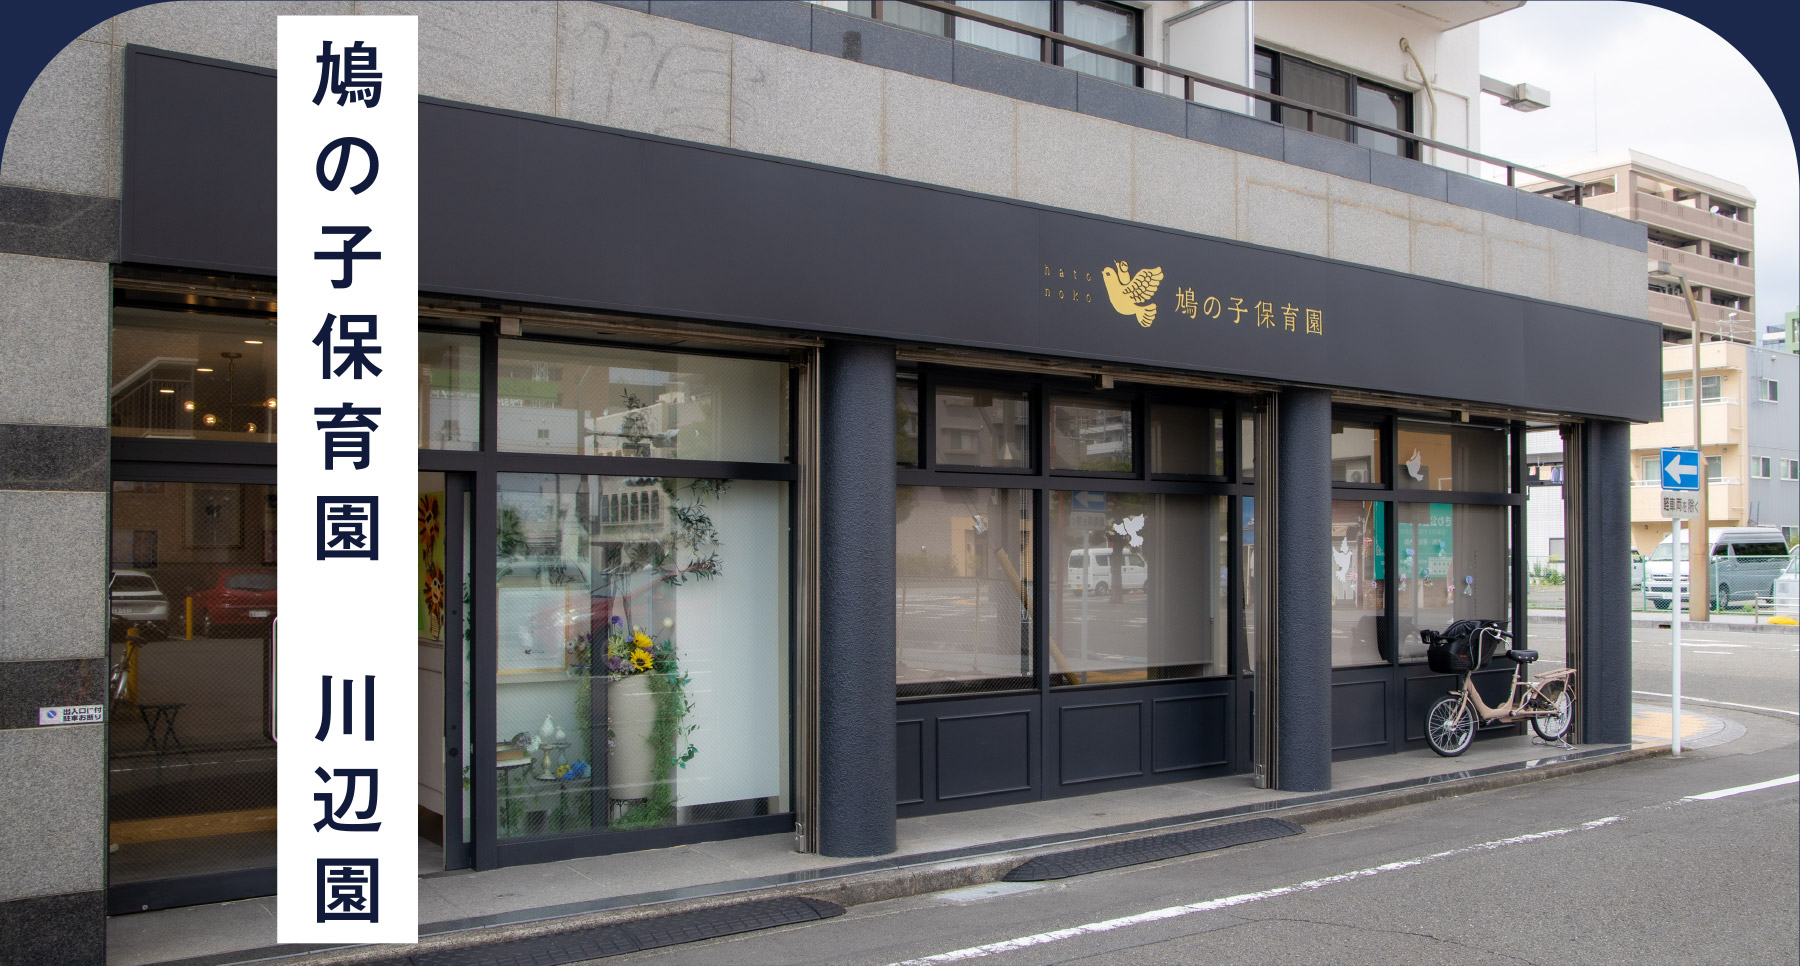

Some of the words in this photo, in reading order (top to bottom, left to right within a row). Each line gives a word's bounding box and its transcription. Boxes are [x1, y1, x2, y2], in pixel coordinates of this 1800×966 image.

[1174, 286, 1324, 336] 鳩の子保育園
[63, 714, 102, 722] 駐車お断り
